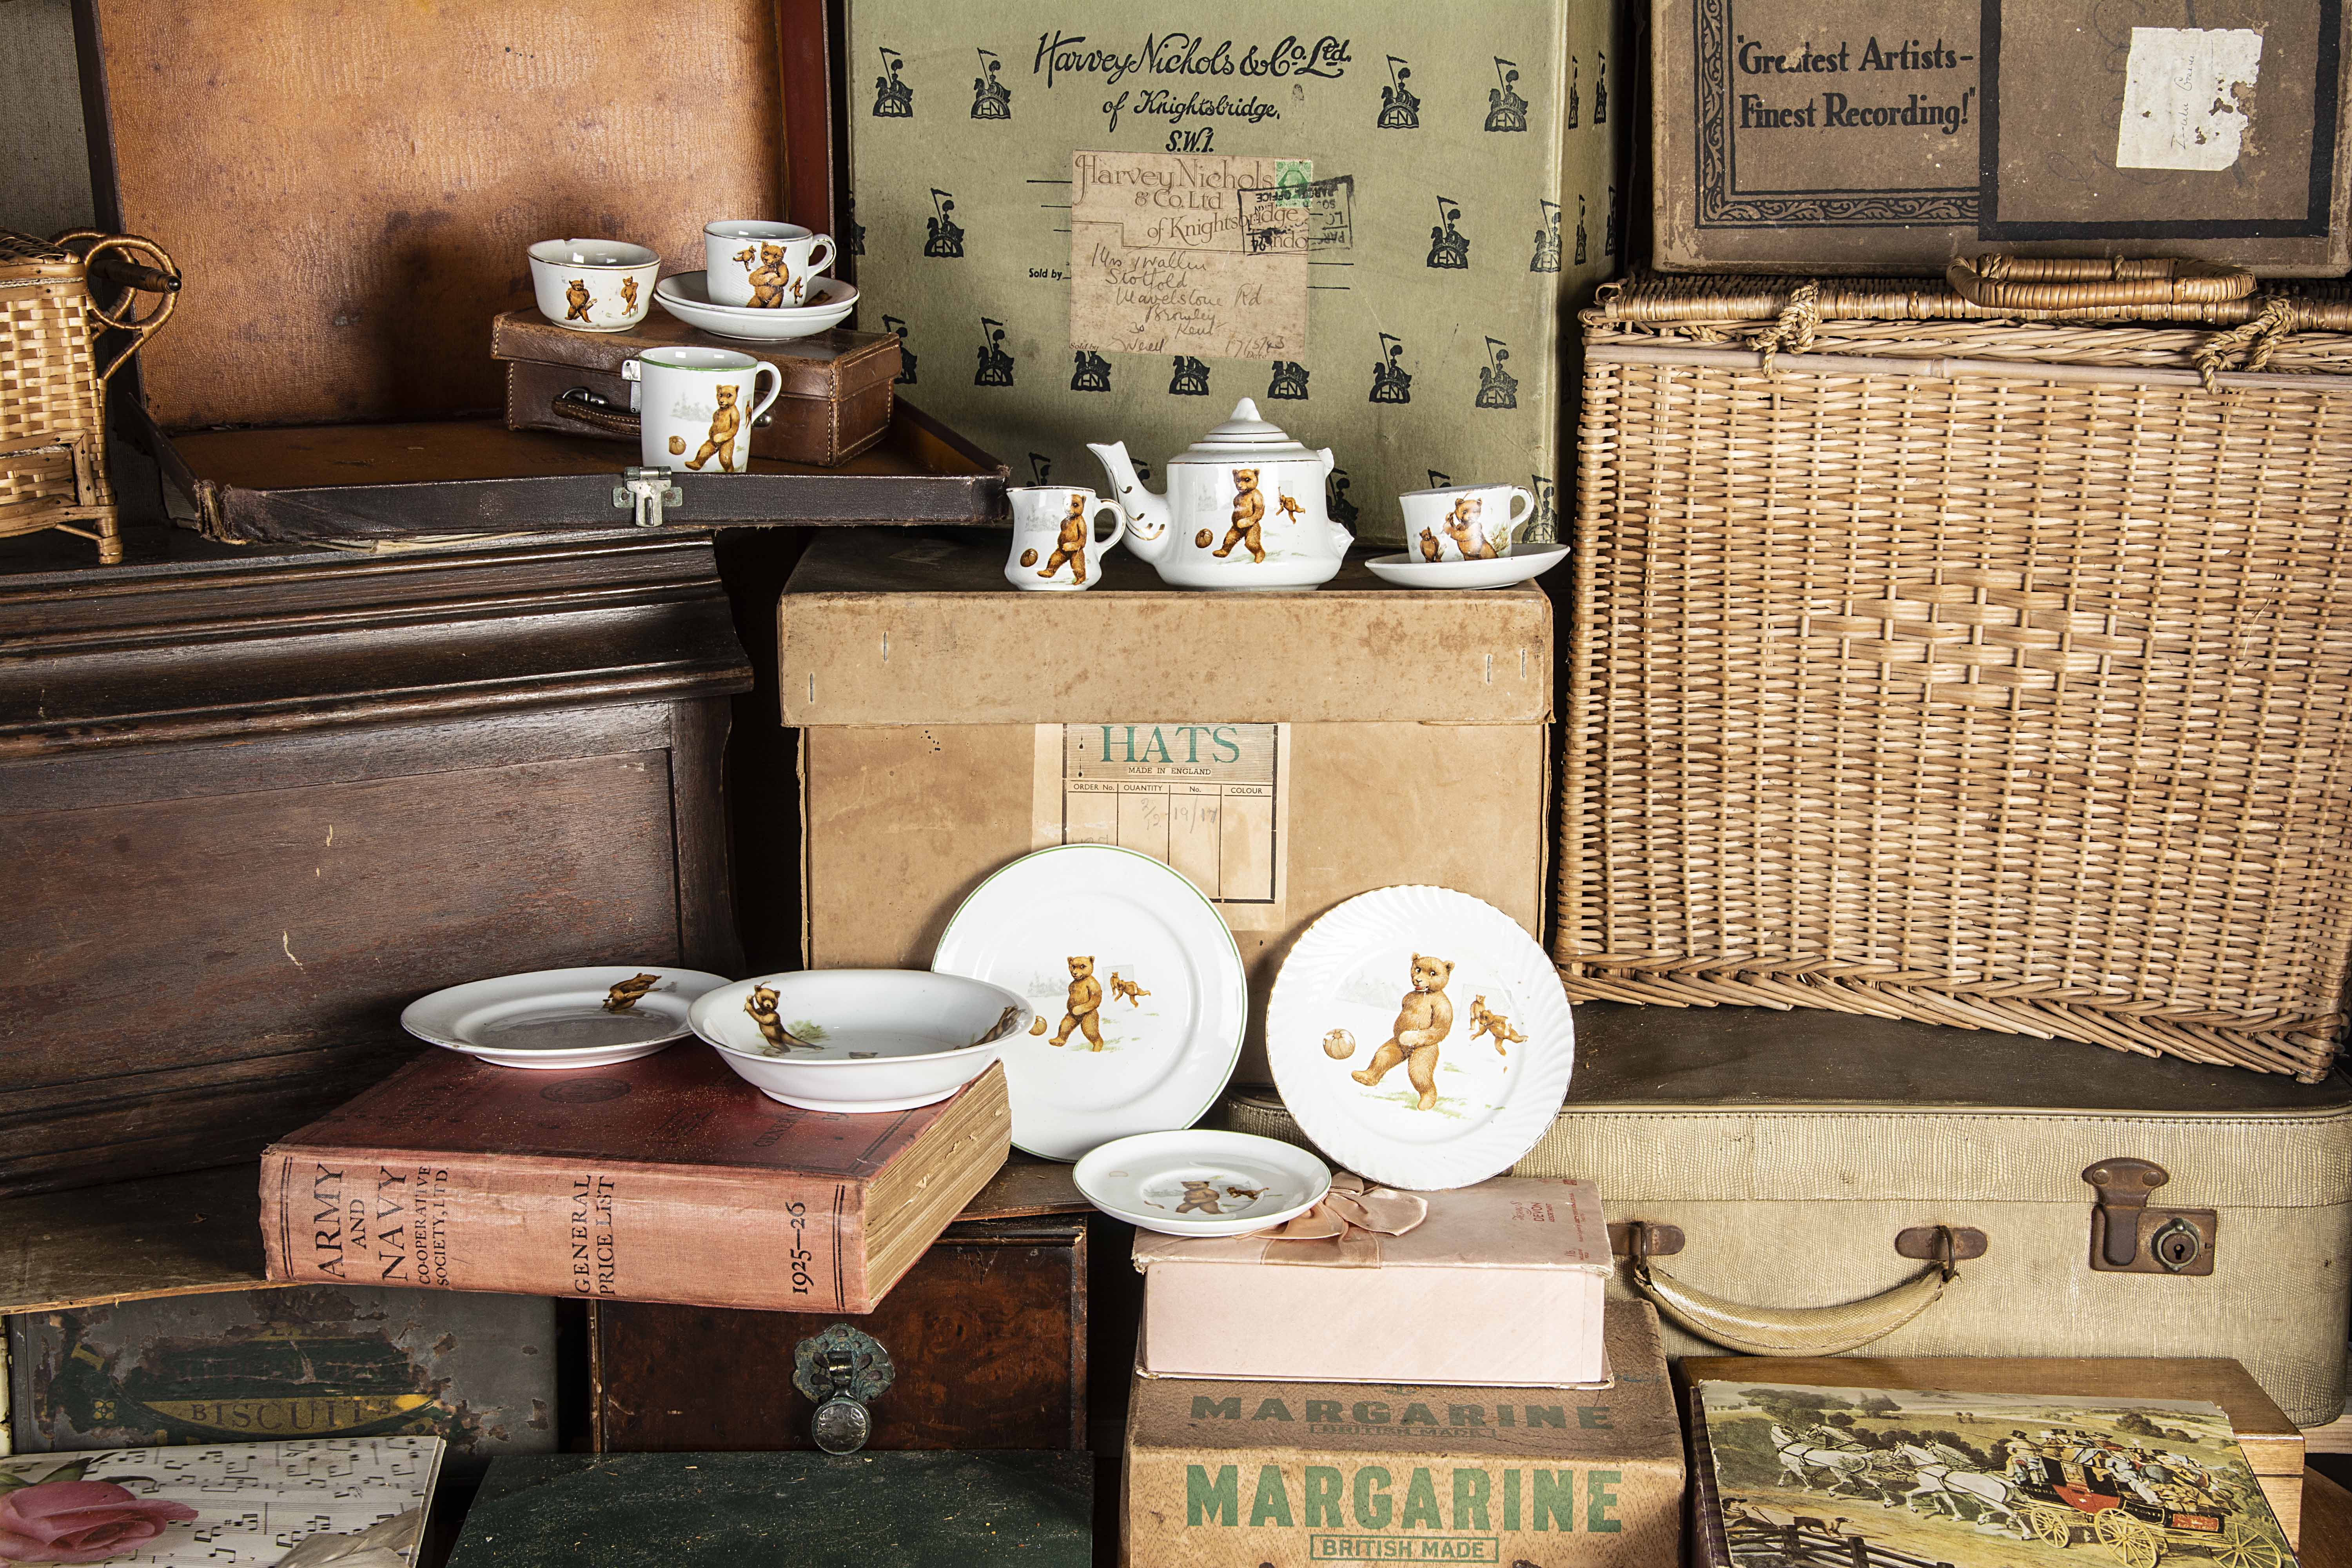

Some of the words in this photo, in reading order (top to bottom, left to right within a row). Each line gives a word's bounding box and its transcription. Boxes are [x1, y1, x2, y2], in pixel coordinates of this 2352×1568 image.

[1033, 30, 1136, 89] Harvey
[1131, 32, 1234, 76] Nichols
[1102, 91, 1129, 132] of
[1739, 94, 1817, 129] Finest
[1822, 86, 1976, 134] Recording!"
[1075, 153, 1174, 205] Harvey
[1176, 158, 1274, 189] Nichols
[1256, 190, 1292, 203] OFFICE
[1135, 191, 1147, 206] &
[1153, 189, 1184, 209] Co.
[1188, 190, 1224, 210] Ltd
[1147, 220, 1164, 246] of
[1171, 209, 1298, 246] Knightsbridge
[1029, 268, 1048, 278] Sold
[1051, 269, 1063, 281] by
[1234, 283, 1263, 307] Rd
[1090, 343, 1099, 352] by
[1175, 320, 1218, 339] Kent
[1246, 350, 1267, 359] Date
[1101, 726, 1240, 763] HATS
[1128, 766, 1152, 775] MADE
[596, 1175, 615, 1227] LIST
[1531, 1202, 1545, 1222] DEVON
[314, 1161, 345, 1279] ARMY
[350, 1199, 367, 1250] AND
[377, 1165, 408, 1282] NAVY
[415, 1165, 432, 1285] CO-OPERATIVE
[572, 1174, 591, 1294] GENERAL
[597, 1234, 615, 1295] PRICE
[191, 1398, 392, 1430] BISCUITS
[1190, 1396, 1614, 1430] MARGARINE
[1419, 1428, 1481, 1437] MADE
[1187, 1464, 1622, 1533] MARGARINE
[1322, 1538, 1410, 1559] BRITISH
[1421, 1539, 1484, 1560] MADE
